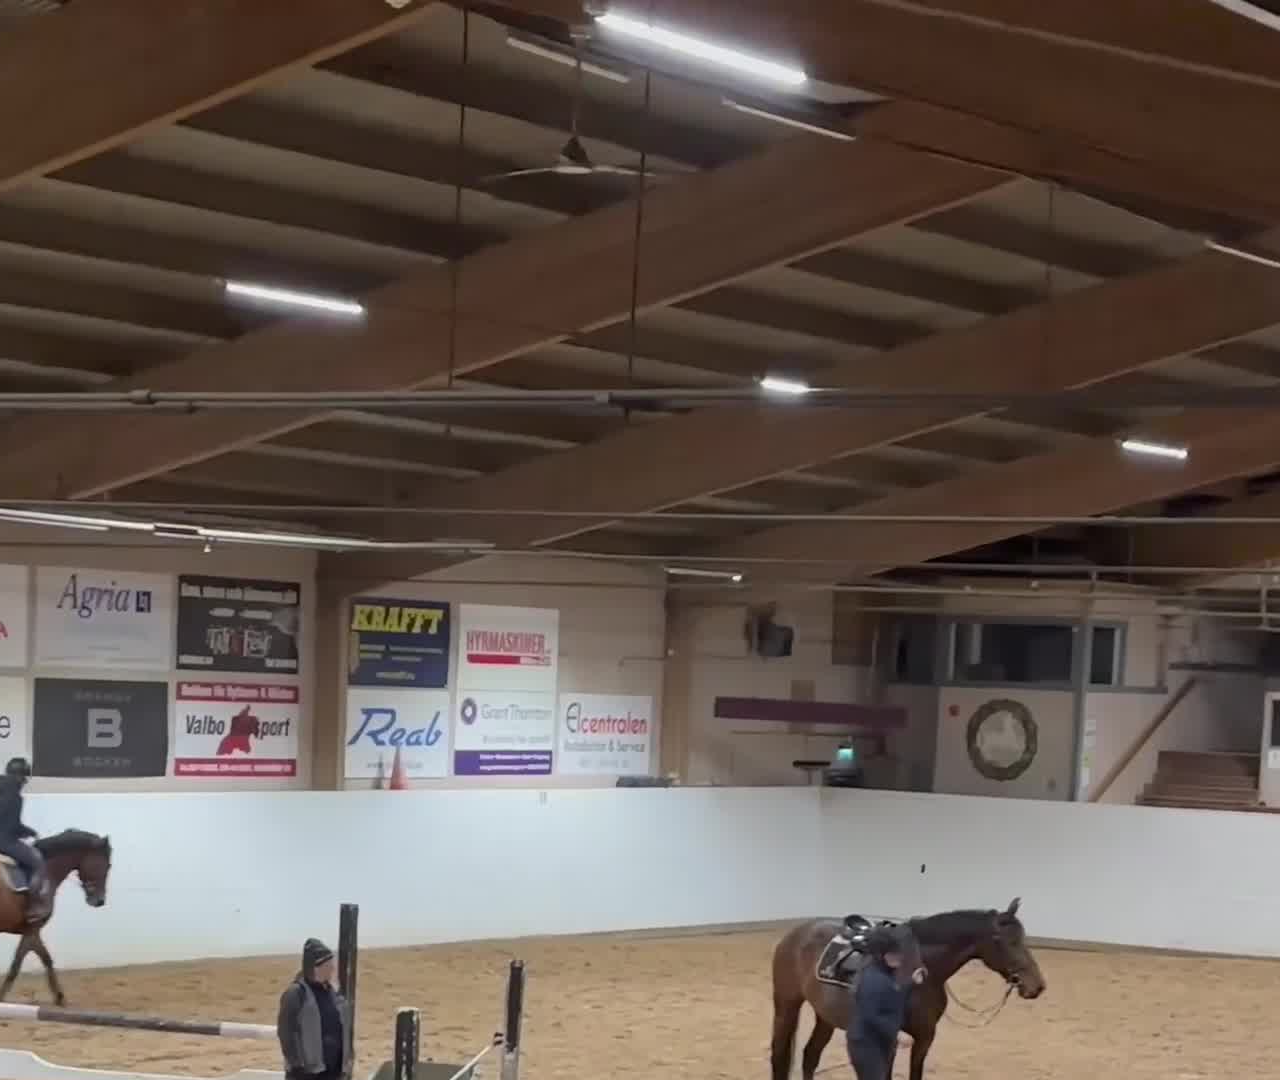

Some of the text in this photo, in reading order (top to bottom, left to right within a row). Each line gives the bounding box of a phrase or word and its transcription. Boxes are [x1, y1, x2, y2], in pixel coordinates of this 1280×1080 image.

[56, 574, 131, 618] Agria
[352, 605, 444, 634] KRAFFT
[87, 708, 124, 748] B
[186, 714, 225, 736] Valbo
[347, 708, 442, 747] Reab
[566, 702, 648, 735] Elcentralen
